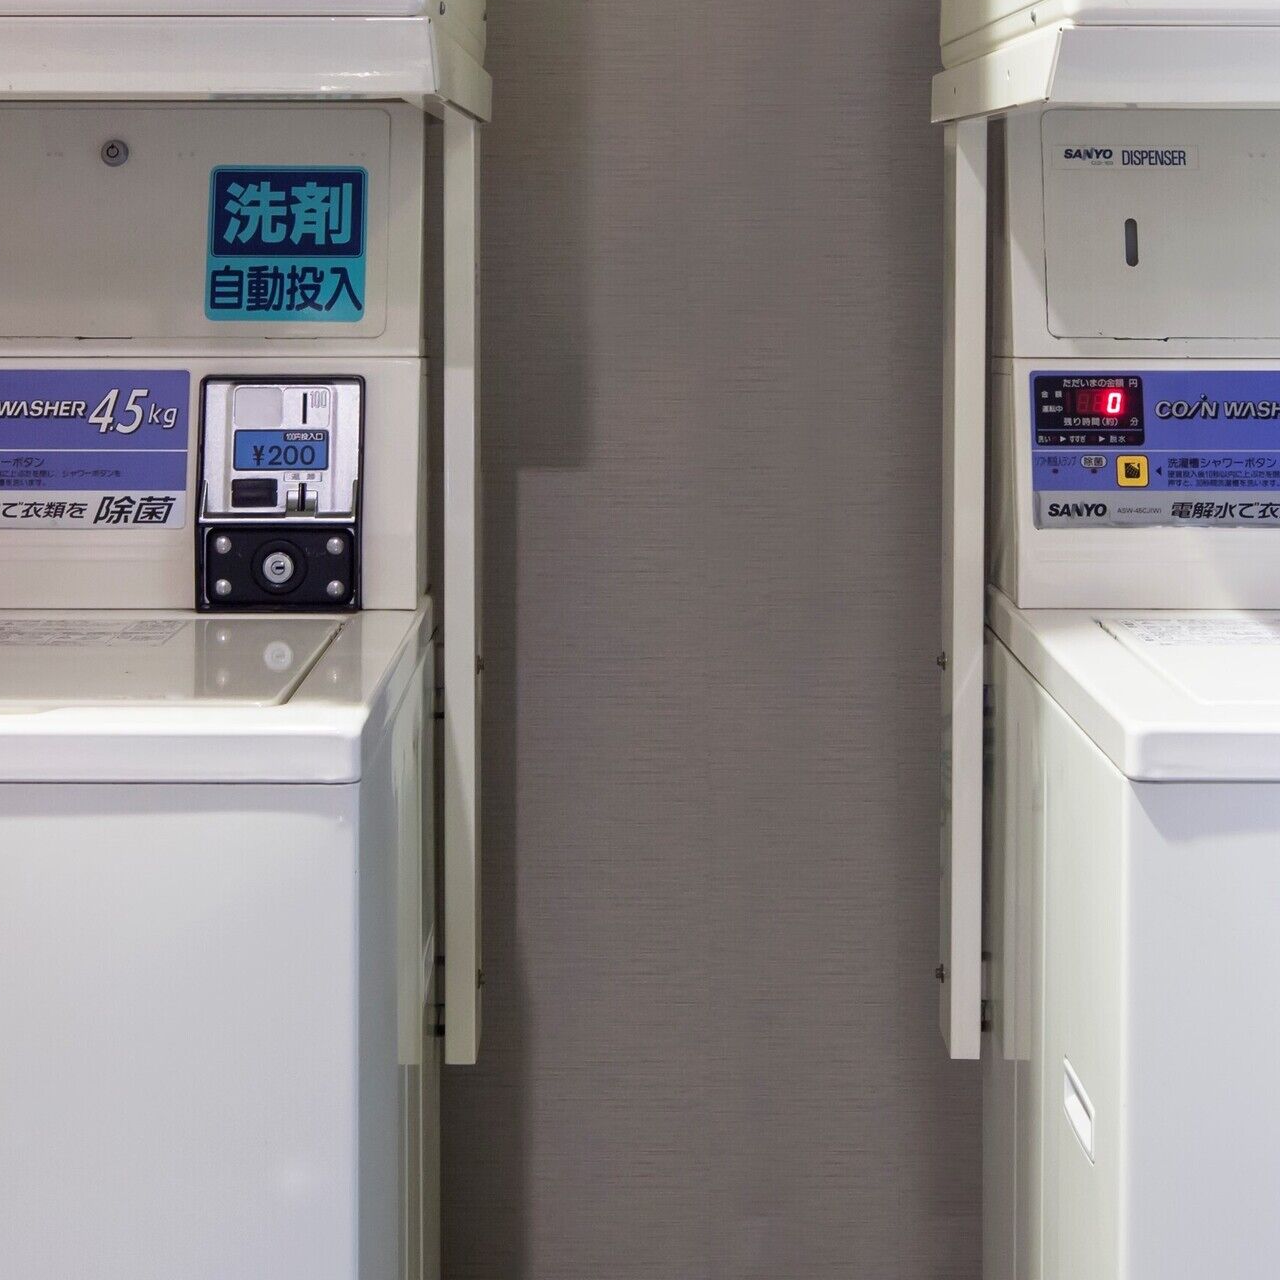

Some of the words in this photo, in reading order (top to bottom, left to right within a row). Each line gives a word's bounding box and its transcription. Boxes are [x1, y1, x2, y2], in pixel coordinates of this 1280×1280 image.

[1064, 148, 1113, 160] SANYO
[1122, 150, 1186, 165] DISPENSER
[224, 181, 353, 245] 洗剤
[211, 266, 362, 311] 自動投入
[1063, 379, 1124, 387] ただいまの金額
[1107, 393, 1121, 413] 0
[148, 404, 177, 429] kg
[253, 445, 315, 466] ¥200
[93, 496, 175, 524] 除菌
[1048, 502, 1107, 519] SANYO
